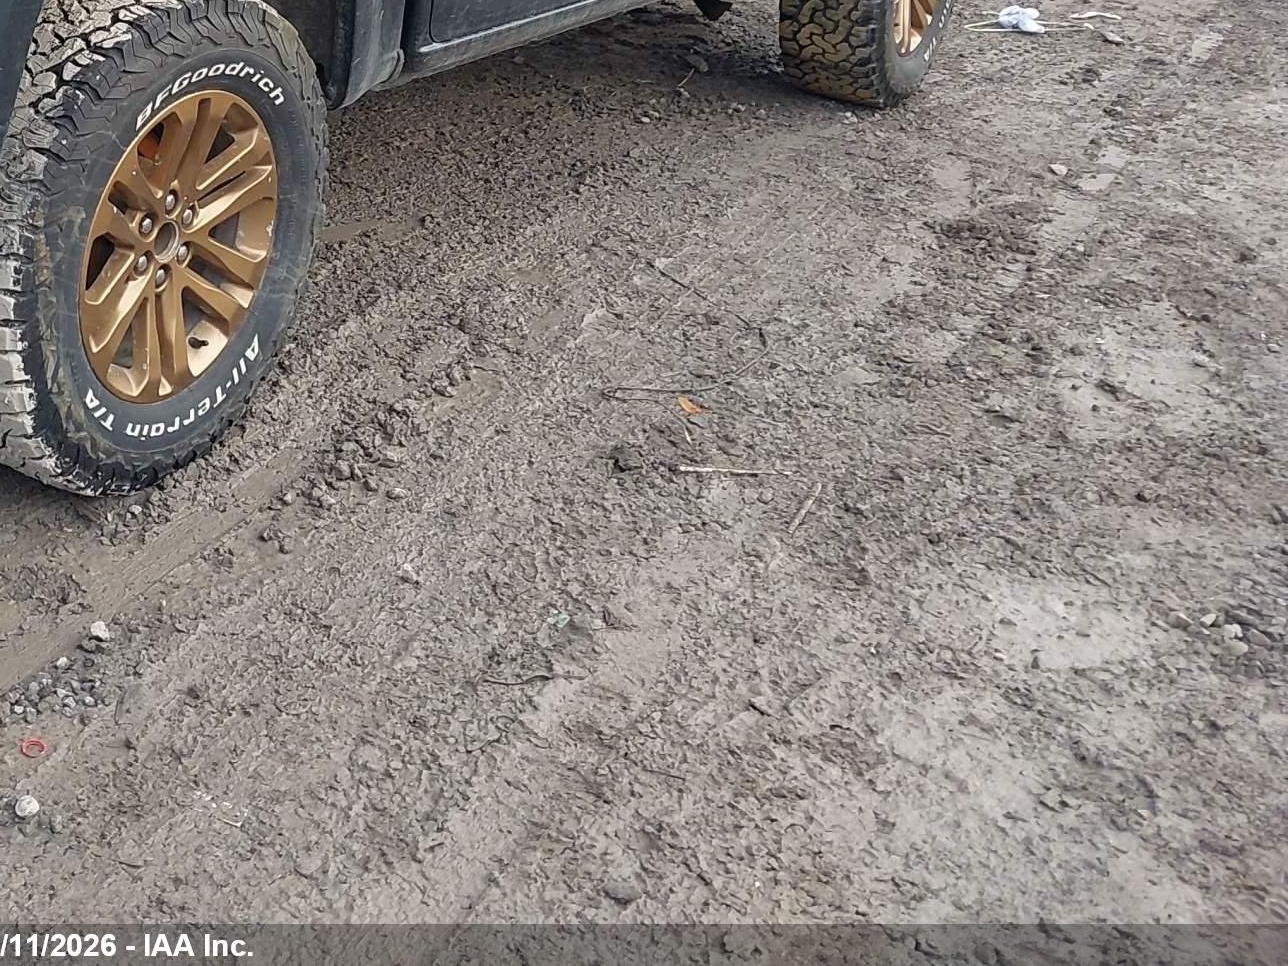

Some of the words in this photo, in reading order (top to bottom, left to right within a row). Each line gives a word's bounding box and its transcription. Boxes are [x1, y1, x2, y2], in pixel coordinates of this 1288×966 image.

[135, 61, 286, 132] BFGoodrich
[84, 388, 116, 432] T/A
[125, 333, 260, 441] All-Terrain
